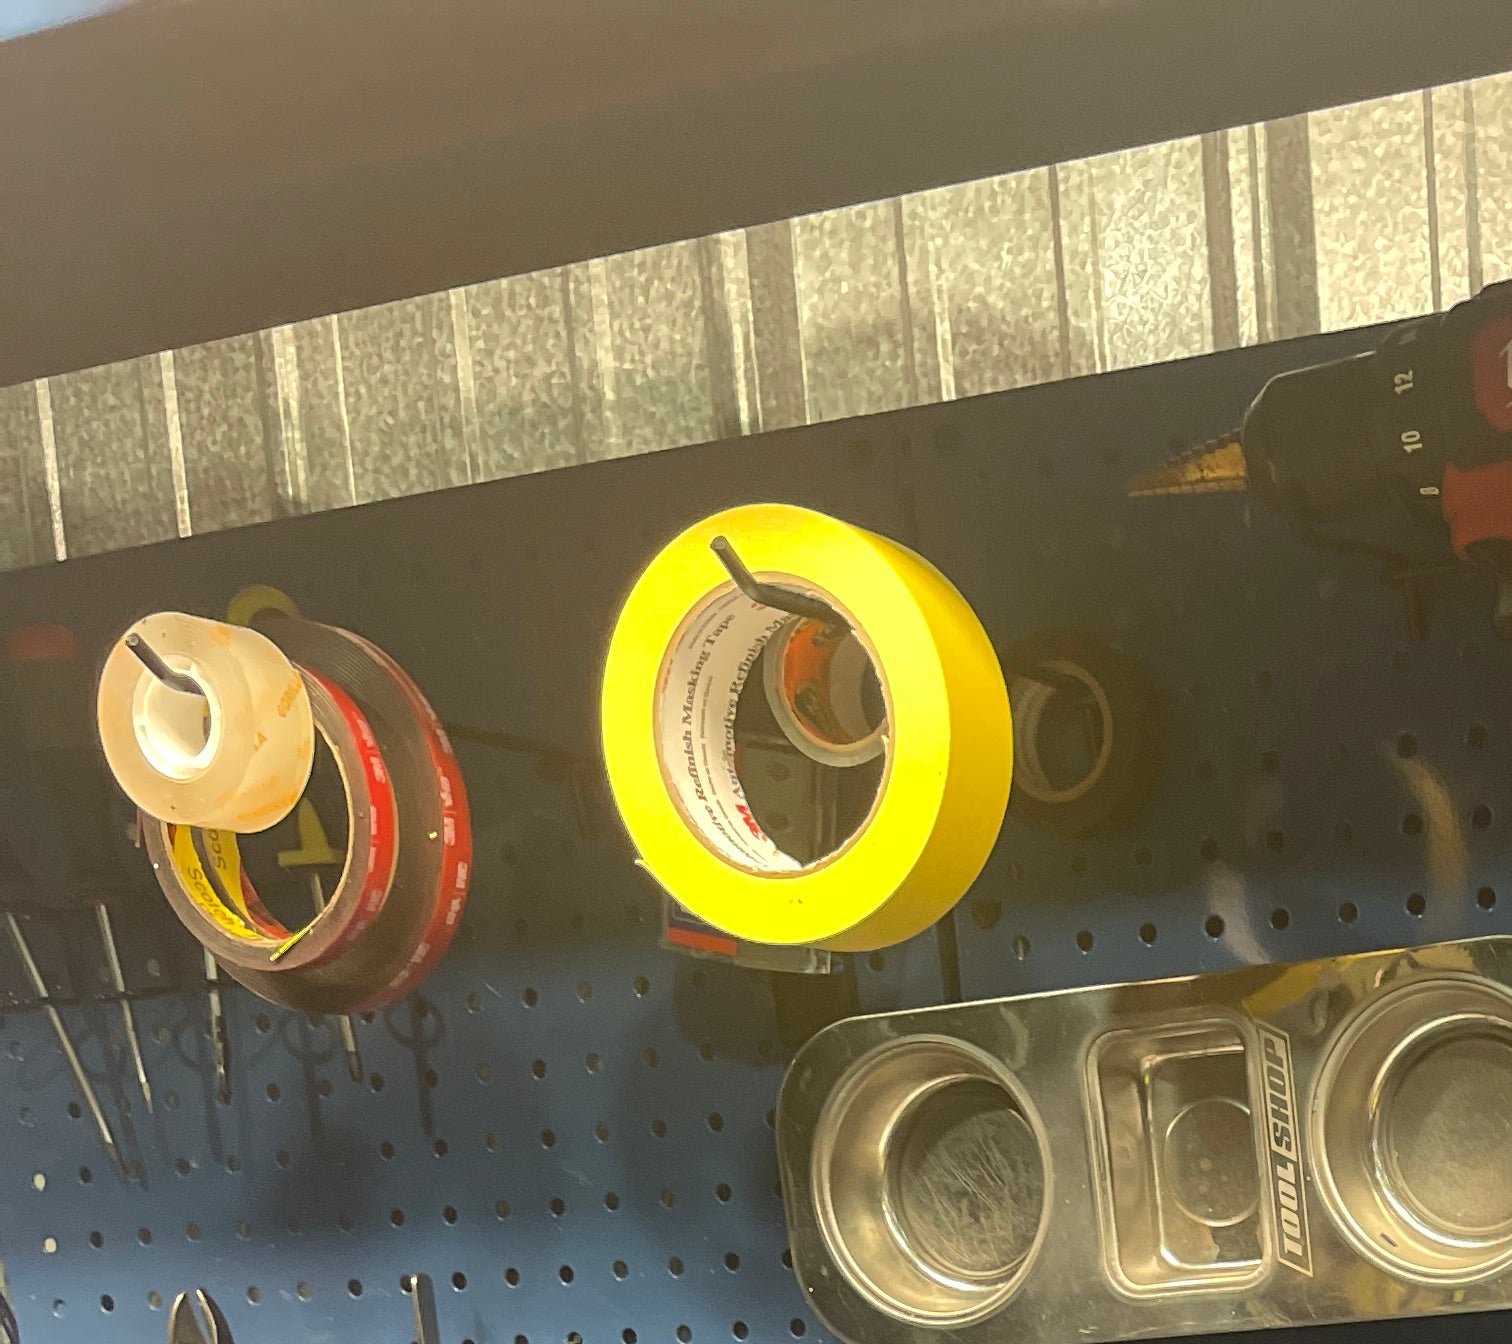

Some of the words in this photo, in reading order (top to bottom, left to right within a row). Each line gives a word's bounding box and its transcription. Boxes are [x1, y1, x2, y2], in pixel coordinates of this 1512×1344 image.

[1394, 370, 1414, 395] 12
[1401, 430, 1423, 453] 10
[702, 612, 735, 652] Tape
[682, 649, 711, 726] Masking
[681, 730, 707, 802] Refinish
[187, 866, 236, 926] Scotch
[1264, 1037, 1293, 1153] SHOP
[1277, 1160, 1303, 1257] TOOL
